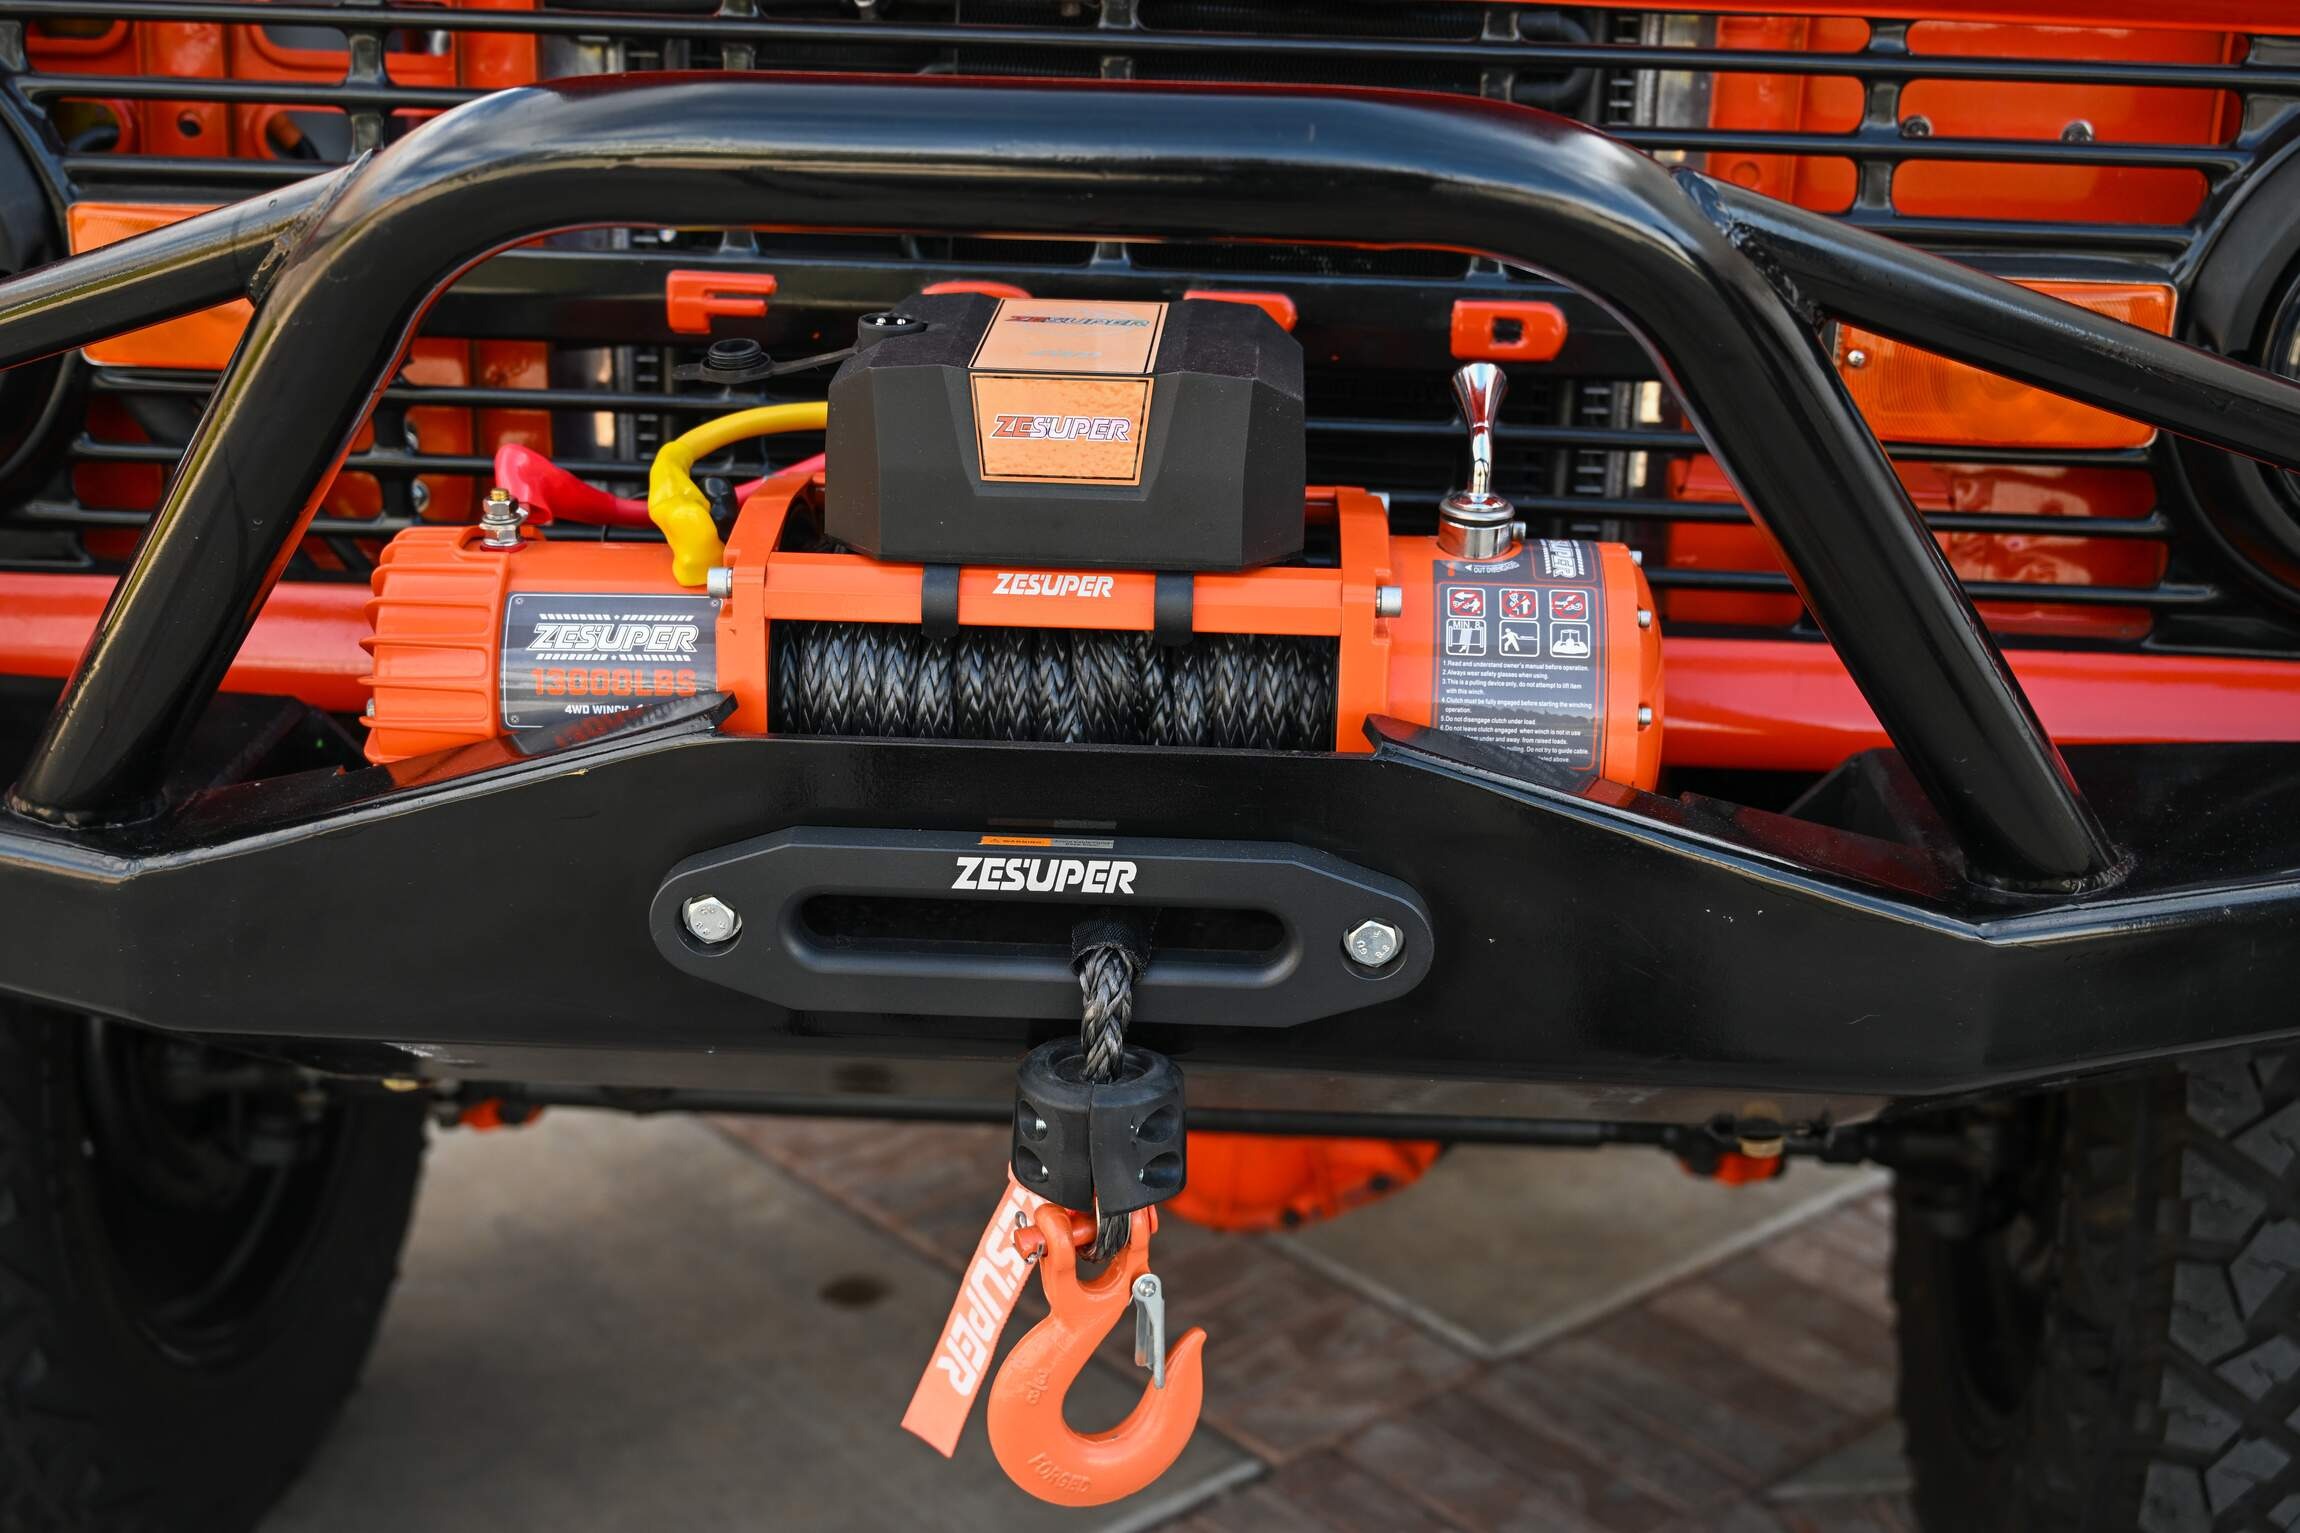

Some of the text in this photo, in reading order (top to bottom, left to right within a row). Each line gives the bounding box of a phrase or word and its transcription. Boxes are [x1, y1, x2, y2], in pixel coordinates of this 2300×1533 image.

[991, 414, 1132, 442] ZESUPER
[992, 572, 1114, 598] ZESUPER
[526, 623, 700, 653] ZESUPER
[530, 668, 697, 697] 13000LBS
[564, 704, 590, 714] 4WD
[951, 856, 1138, 894] ZESUPER
[1027, 1451, 1092, 1492] FORGED
